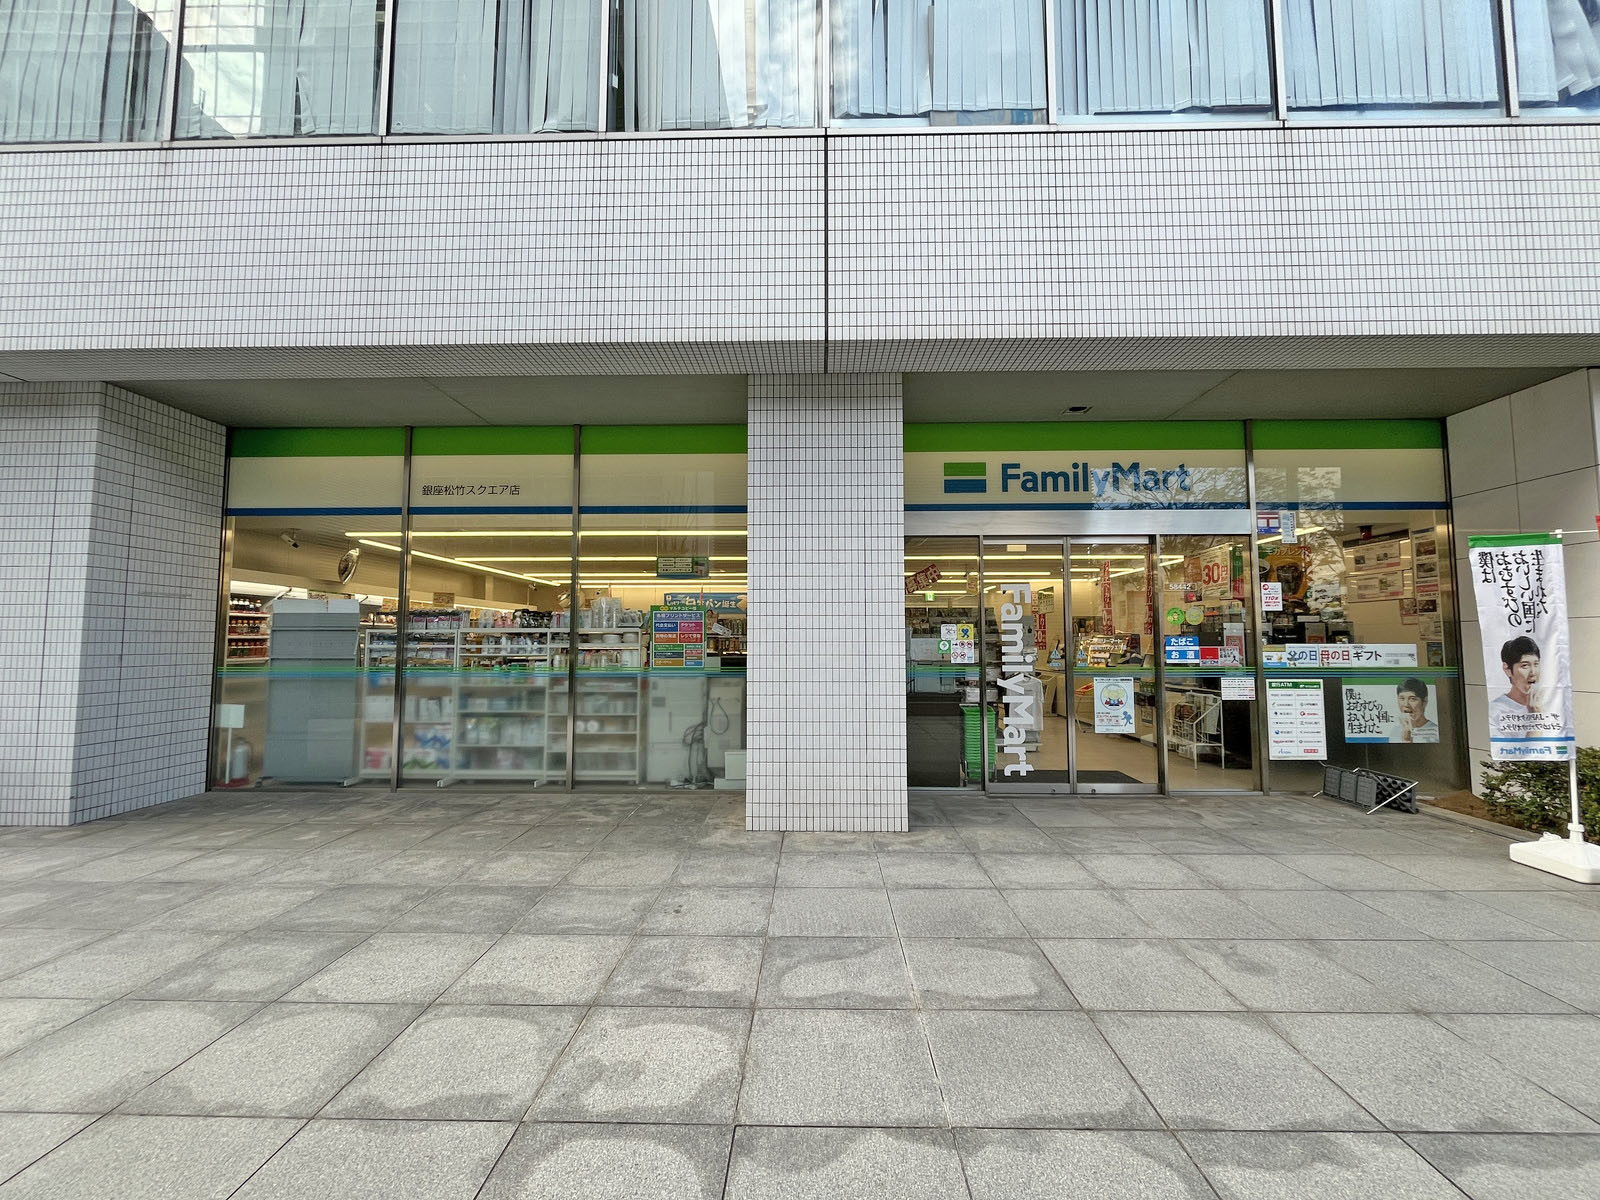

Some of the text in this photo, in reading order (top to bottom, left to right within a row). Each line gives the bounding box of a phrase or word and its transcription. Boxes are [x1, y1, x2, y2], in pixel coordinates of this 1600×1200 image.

[1001, 462, 1191, 497] FamilyMart
[421, 484, 521, 496] 銀座松竹スクエア店
[1170, 637, 1194, 646] たばこ
[1286, 650, 1318, 661] 父の日
[1319, 650, 1350, 661] 母の日
[1352, 650, 1382, 661] ギフト
[997, 582, 1035, 777] FamilyMart
[1345, 688, 1361, 701] 僕は
[1346, 700, 1383, 712] おむすびの
[1347, 711, 1395, 723] おいしい国に
